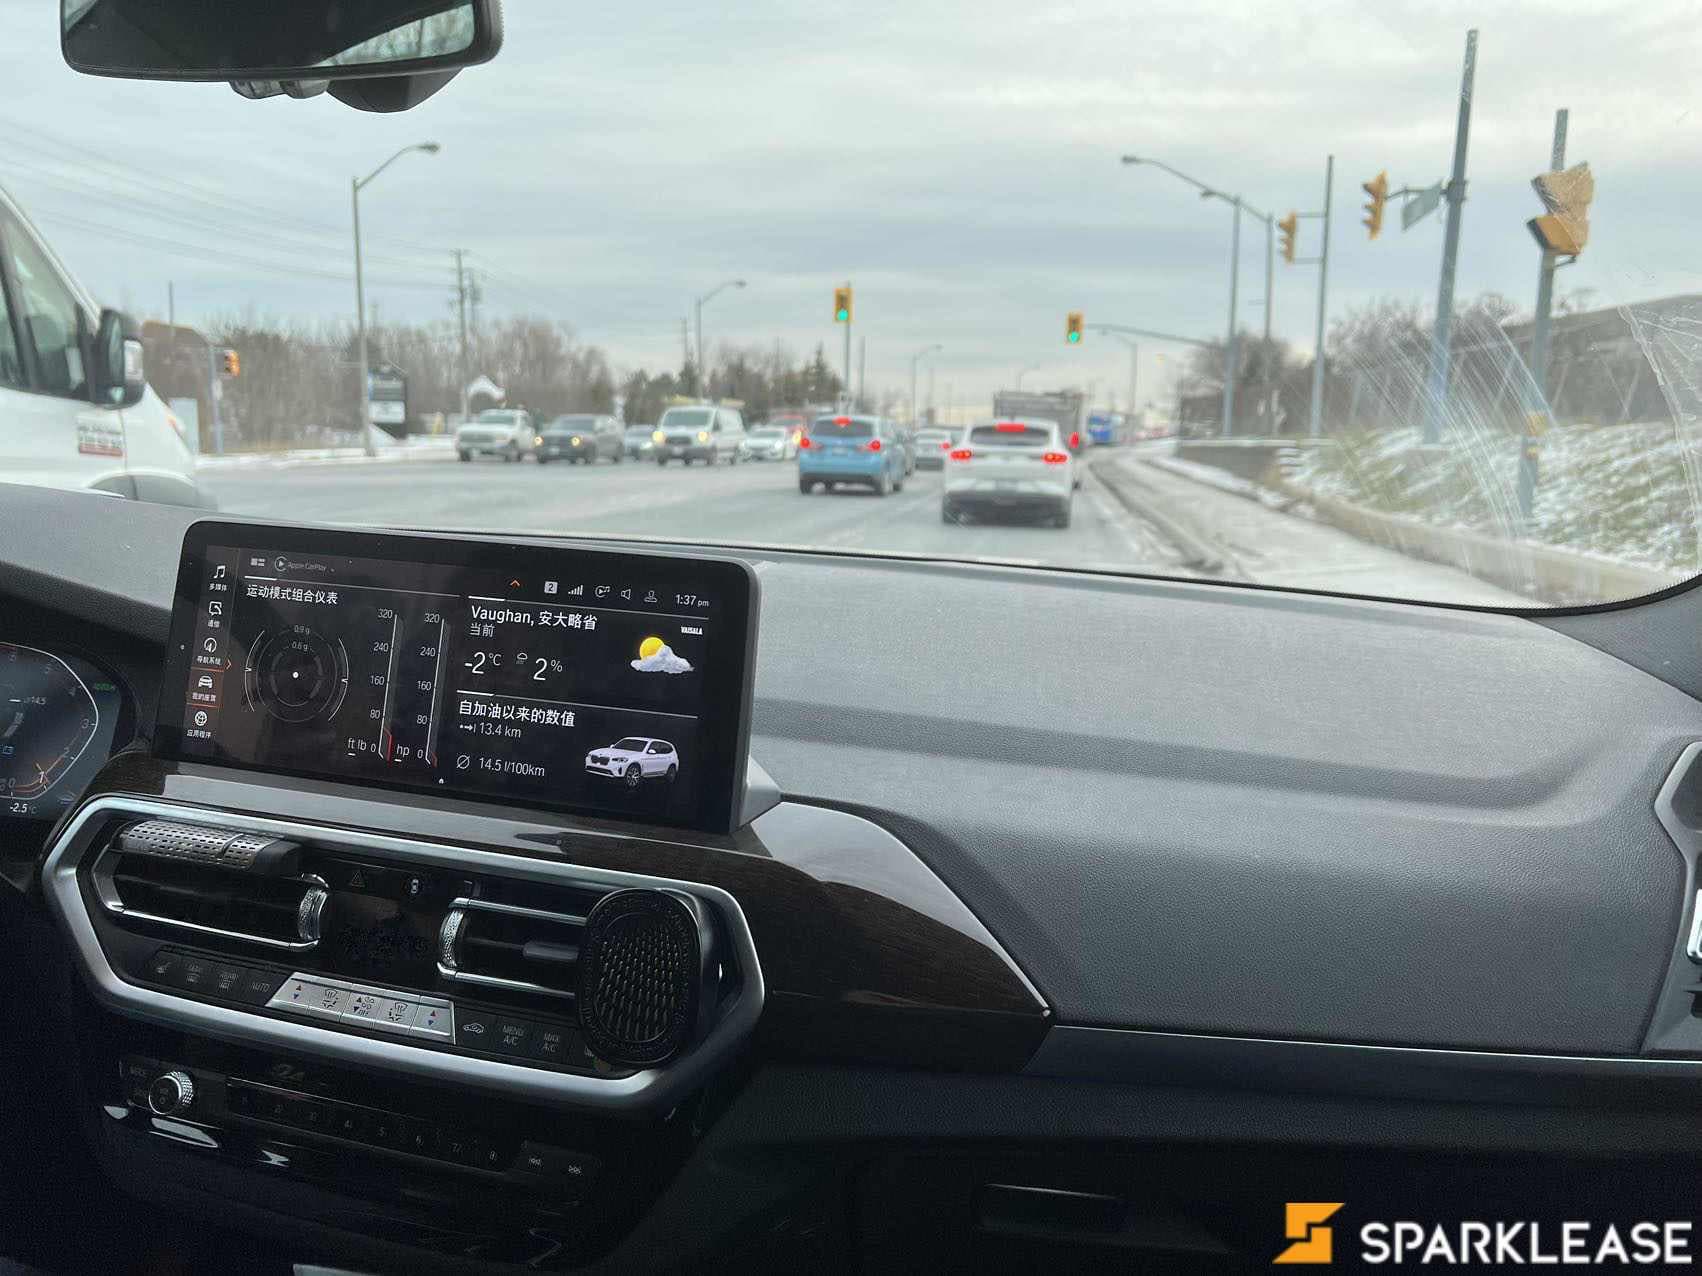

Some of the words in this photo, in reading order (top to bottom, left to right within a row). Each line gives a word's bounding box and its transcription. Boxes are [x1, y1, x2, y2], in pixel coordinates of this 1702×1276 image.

[246, 584, 339, 605] 运动模式组合仪表
[675, 593, 697, 606] 1:37
[697, 599, 709, 608] pm
[378, 608, 393, 619] 320
[424, 613, 440, 623] 320
[471, 605, 535, 627] Vaughan,
[538, 610, 598, 631] 安大略省
[469, 622, 495, 638] 当前
[373, 642, 389, 652] 240
[420, 646, 436, 657] 240
[370, 675, 385, 685] 160
[417, 680, 432, 691] 160
[370, 709, 381, 719] 80
[458, 700, 576, 727] 自加油以来的数值
[417, 715, 428, 725] 80
[479, 721, 502, 736] 13.4
[504, 725, 522, 739] km
[370, 743, 377, 753] 0
[396, 744, 410, 757] hp
[417, 749, 424, 759] 0
[479, 757, 502, 772] 14.5
